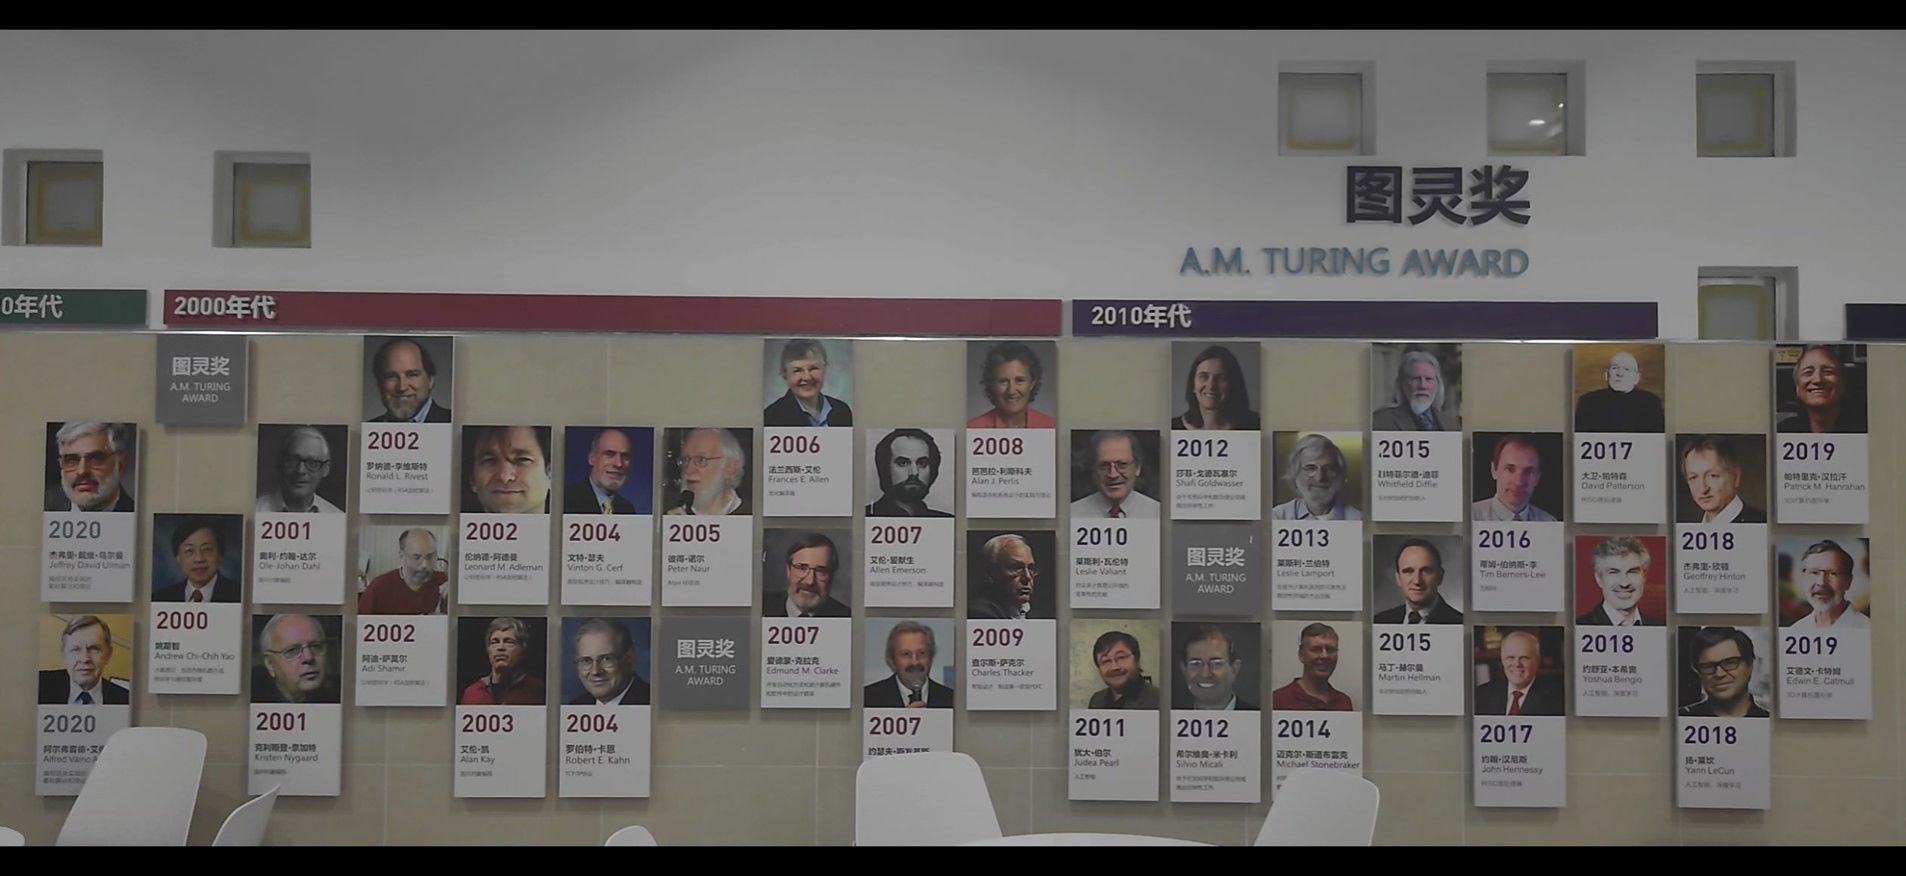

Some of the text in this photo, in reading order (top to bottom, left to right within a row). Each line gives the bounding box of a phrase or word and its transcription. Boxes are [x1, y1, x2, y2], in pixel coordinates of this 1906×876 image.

[1347, 165, 1530, 225] 图灵奖
[1180, 248, 1530, 277] A.M. TURING AWARD
[1, 295, 63, 318] 0年代
[174, 295, 276, 319] 2000年代
[1091, 303, 1192, 328] 2010年代
[172, 356, 230, 376] 图灵奖
[194, 382, 231, 391] TURING
[182, 393, 219, 403] AWARD
[368, 432, 419, 450] 2002
[770, 436, 820, 453] 2006
[973, 437, 1023, 455] 2008
[1177, 439, 1228, 457] 2012
[1379, 440, 1429, 458] 2015
[1581, 442, 1632, 459] 2017
[1783, 442, 1834, 460] 2019
[49, 521, 100, 538] 2020
[261, 521, 310, 540] 2001
[466, 522, 517, 540] 2002
[569, 523, 620, 541] 2004
[669, 524, 720, 542] 2005
[871, 526, 922, 544] 2007
[1077, 527, 1127, 545] 2010
[1278, 529, 1328, 547] 2013
[1479, 530, 1530, 548] 2016
[1683, 532, 1734, 550] 2018
[1187, 547, 1246, 567] 图灵奖
[1209, 573, 1247, 583] TURING
[1198, 584, 1235, 593] AWARD
[157, 611, 207, 629] 2000
[364, 624, 415, 642] 2002
[768, 626, 819, 644] 2007
[973, 628, 1023, 646] 2009
[1380, 633, 1430, 651] 2015
[677, 639, 735, 659] 图灵奖
[1582, 634, 1633, 653] 2018
[1785, 636, 1837, 655] 2019
[700, 665, 736, 675] TURING
[687, 676, 724, 686] AWARD
[44, 715, 95, 733] 2020
[257, 712, 305, 731] 2001
[462, 714, 513, 732] 2003
[567, 714, 618, 732] 2004
[870, 717, 921, 735] 2007
[1075, 718, 1124, 736] 2011
[1177, 719, 1228, 737] 2012
[1278, 720, 1330, 738] 2014
[1481, 724, 1532, 743] 2017
[1685, 726, 1736, 744] 2018
